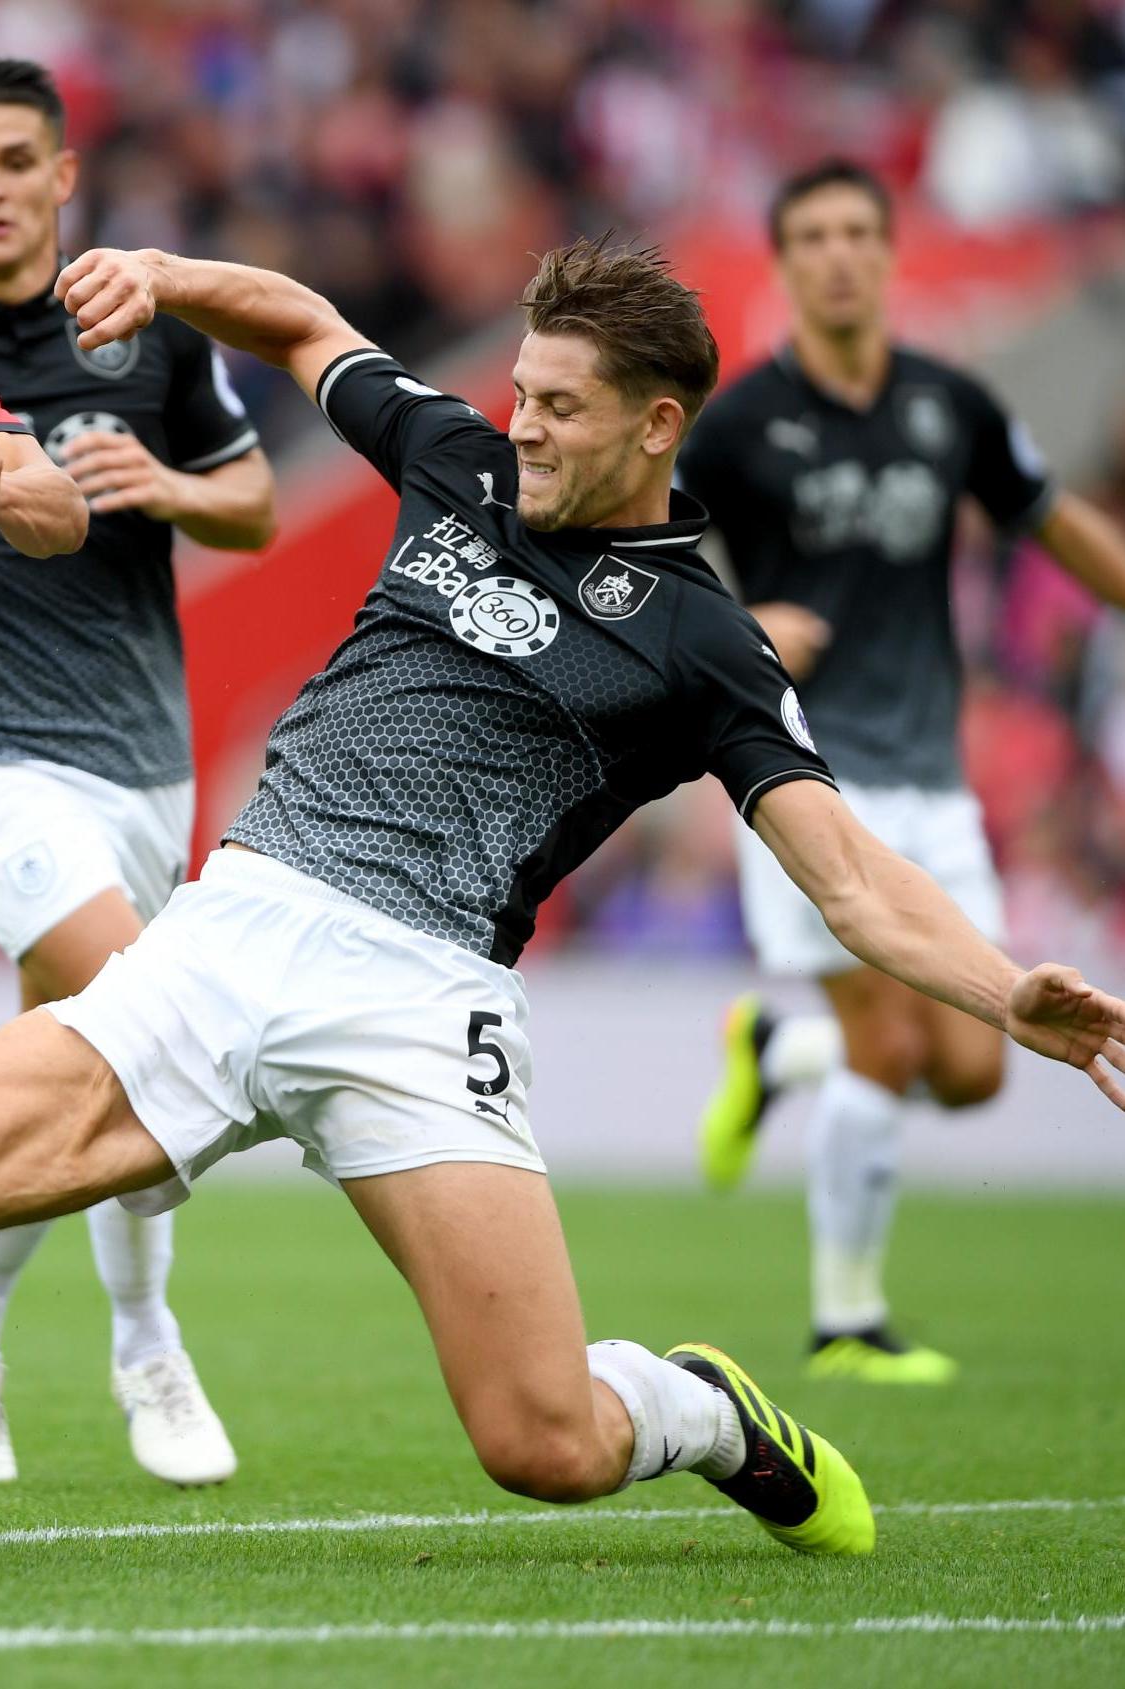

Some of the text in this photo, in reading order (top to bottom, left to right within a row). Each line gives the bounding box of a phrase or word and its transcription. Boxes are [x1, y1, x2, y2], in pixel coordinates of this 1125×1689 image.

[389, 536, 469, 598] LaBa
[478, 596, 530, 634] 360
[466, 1010, 510, 1096] 5
